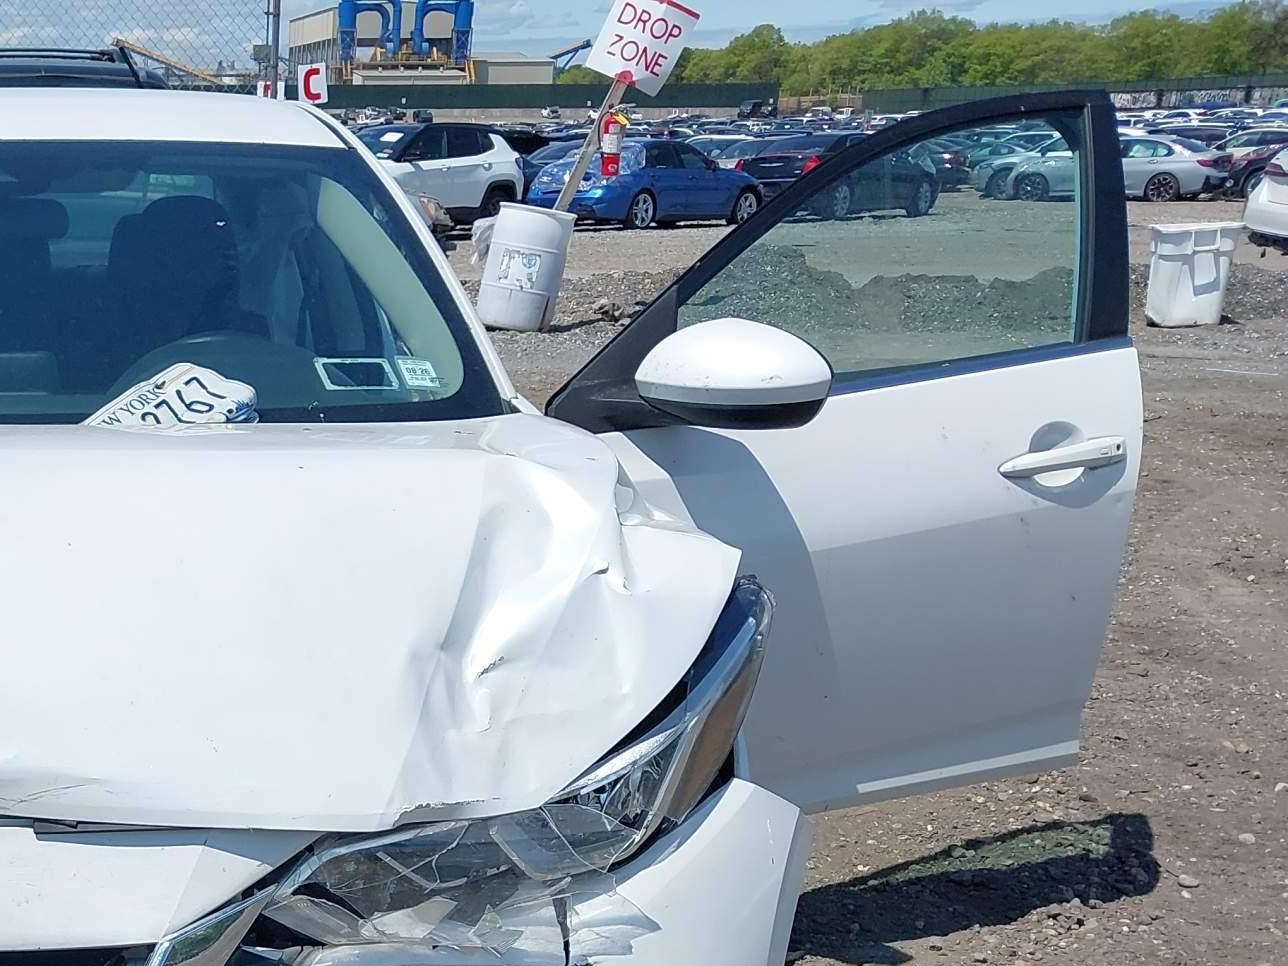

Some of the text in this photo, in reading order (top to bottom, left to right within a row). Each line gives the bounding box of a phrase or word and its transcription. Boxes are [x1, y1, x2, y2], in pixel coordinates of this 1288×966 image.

[617, 2, 683, 45] DROP
[606, 33, 669, 77] ZONE
[303, 67, 322, 101] C
[119, 387, 167, 416] YORK
